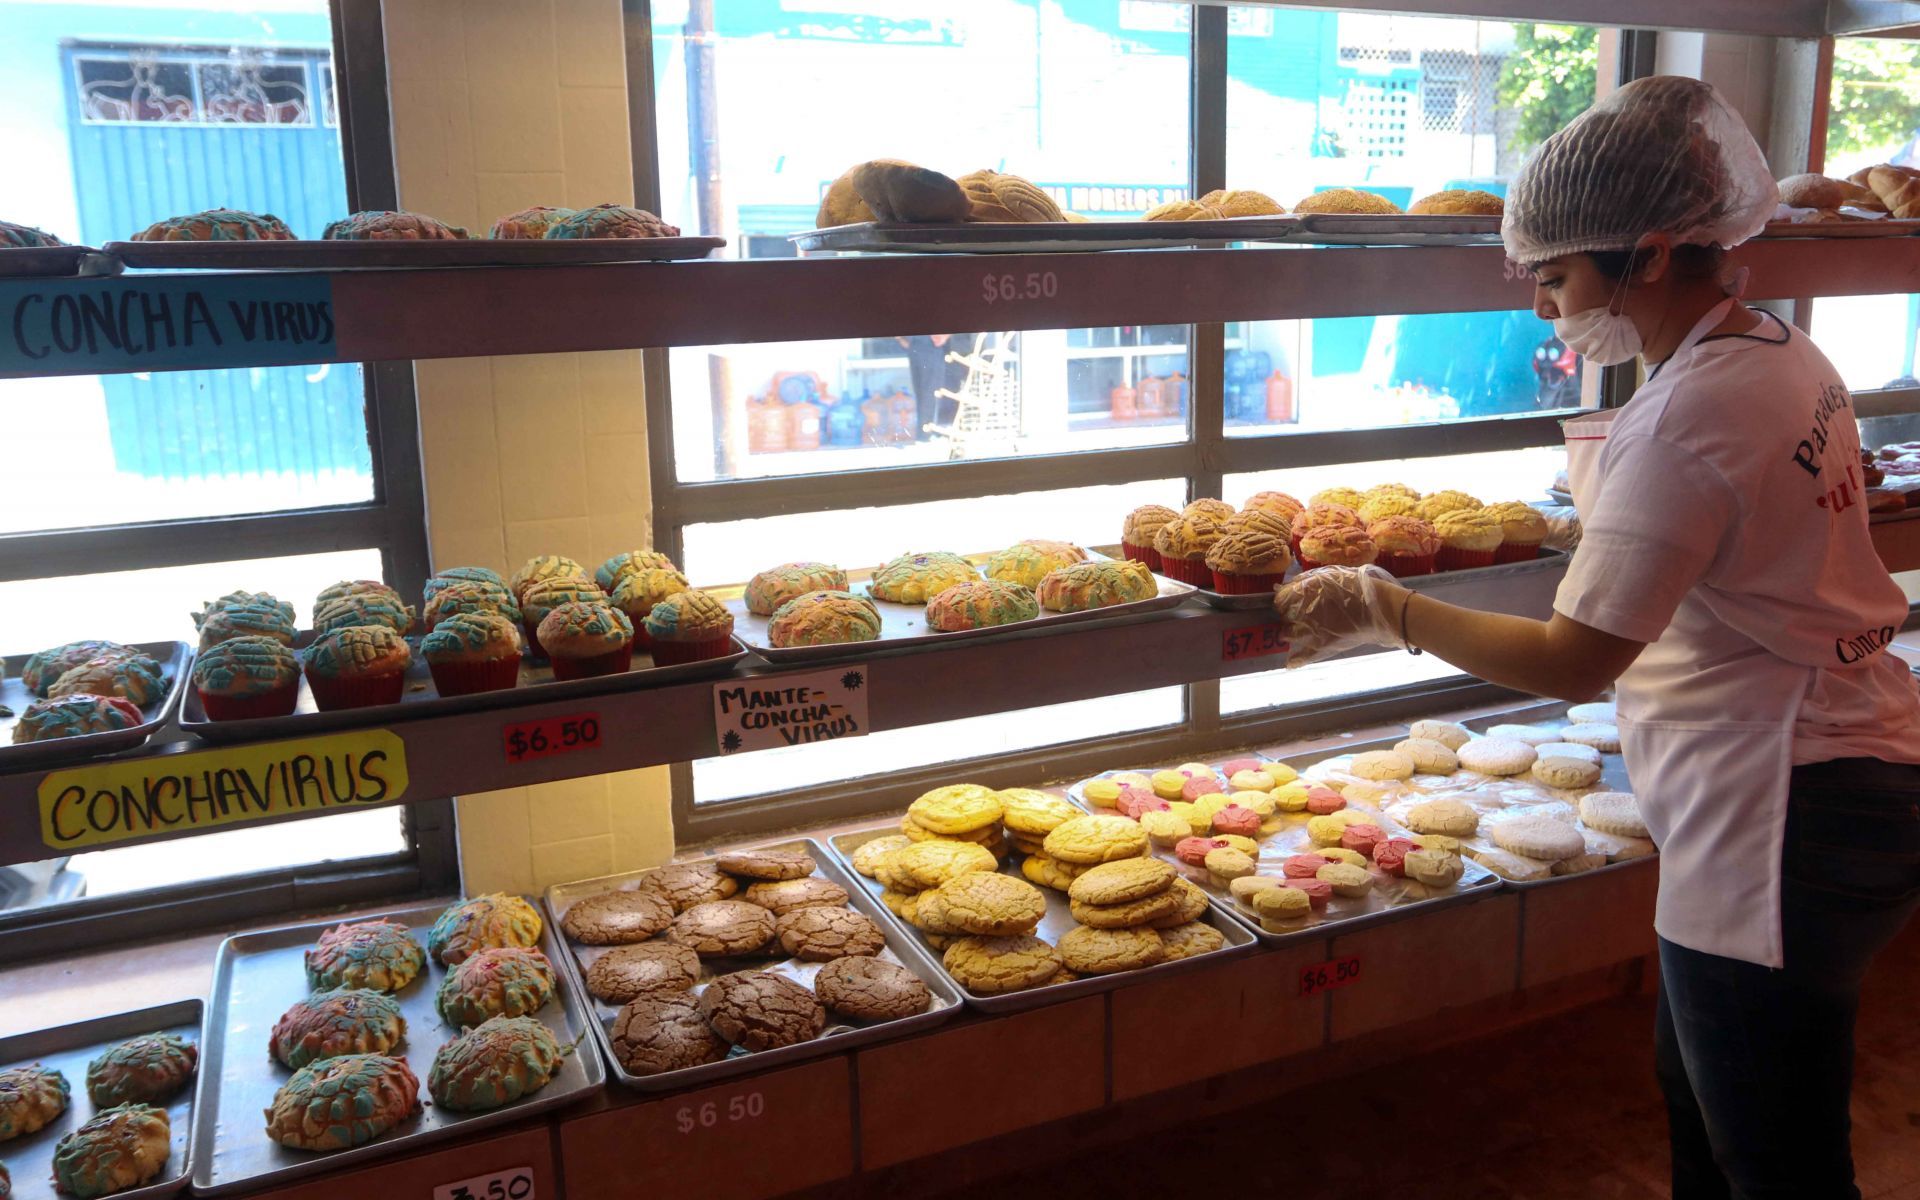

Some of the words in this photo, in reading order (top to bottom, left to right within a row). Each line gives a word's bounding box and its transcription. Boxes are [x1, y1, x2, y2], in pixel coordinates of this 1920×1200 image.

[1071, 187, 1159, 212] MORELOS
[982, 271, 1058, 304] $6.50
[13, 290, 223, 360] CONCHA
[229, 300, 335, 345] VIRUS
[718, 687, 825, 714] MANTE-
[740, 703, 843, 730] CONCHA-
[510, 718, 599, 760] $6.50
[779, 714, 858, 745] VIRUS
[51, 750, 388, 842] CONCHAVIRUS
[1303, 958, 1360, 994] $6.50
